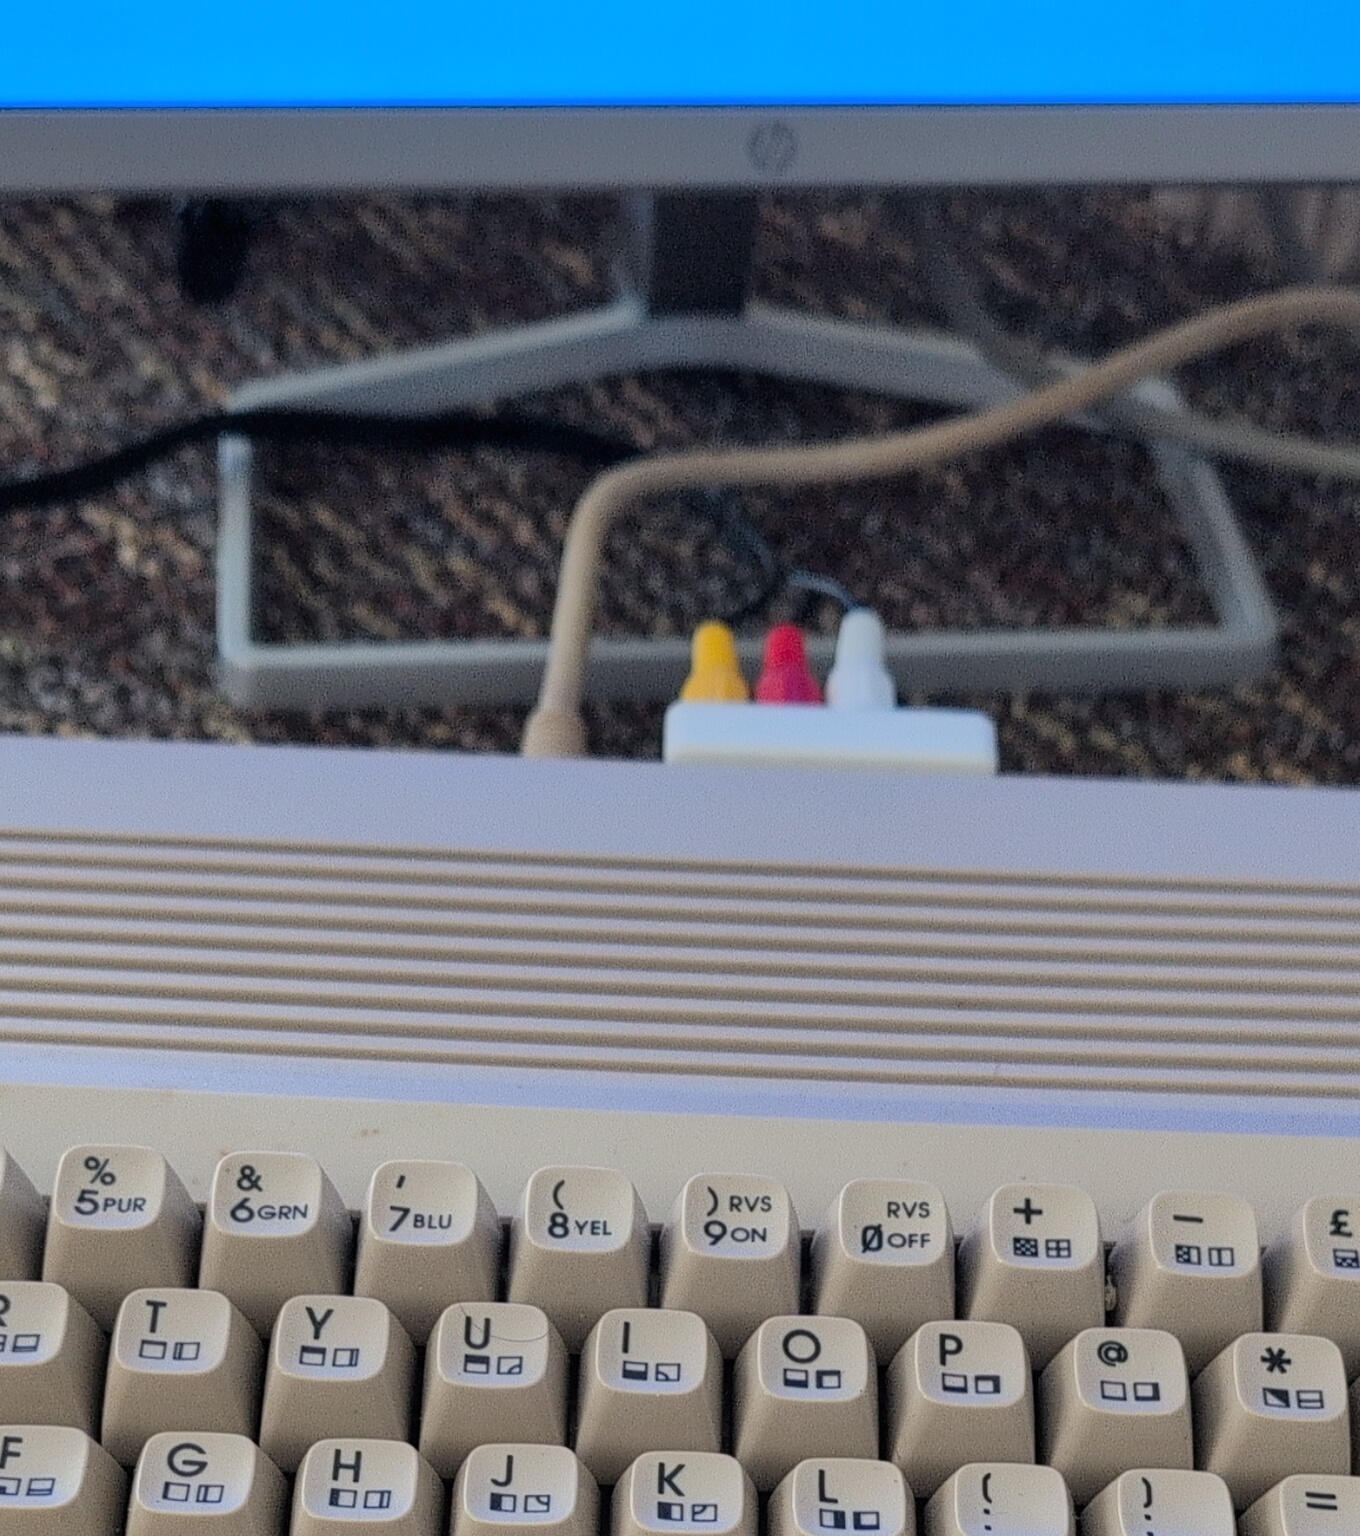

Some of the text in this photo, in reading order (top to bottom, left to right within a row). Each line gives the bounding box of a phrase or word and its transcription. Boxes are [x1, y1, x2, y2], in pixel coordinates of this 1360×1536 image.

[83, 1155, 116, 1186] %
[236, 1164, 263, 1192] &
[74, 1188, 146, 1216] 5 PUR
[229, 1197, 308, 1223] 6 GRN
[728, 1195, 772, 1213] RVS
[886, 1201, 930, 1219] RVS
[1013, 1197, 1043, 1225] +
[389, 1205, 452, 1232] 7 BLU
[547, 1211, 611, 1239] 8 YEL
[703, 1219, 767, 1246] 9 ON
[1330, 1209, 1353, 1238] £
[886, 1232, 930, 1249] OFF
[145, 1299, 167, 1334] T
[305, 1306, 334, 1341] Y
[463, 1315, 491, 1350] U
[621, 1321, 631, 1354] I
[781, 1329, 822, 1364] O
[939, 1333, 963, 1367] P
[1096, 1340, 1129, 1367] @
[166, 1442, 208, 1478] G
[331, 1448, 362, 1483] H
[491, 1454, 514, 1488] J
[657, 1462, 685, 1497] K
[818, 1469, 839, 1504] L
[1305, 1491, 1338, 1511] =
